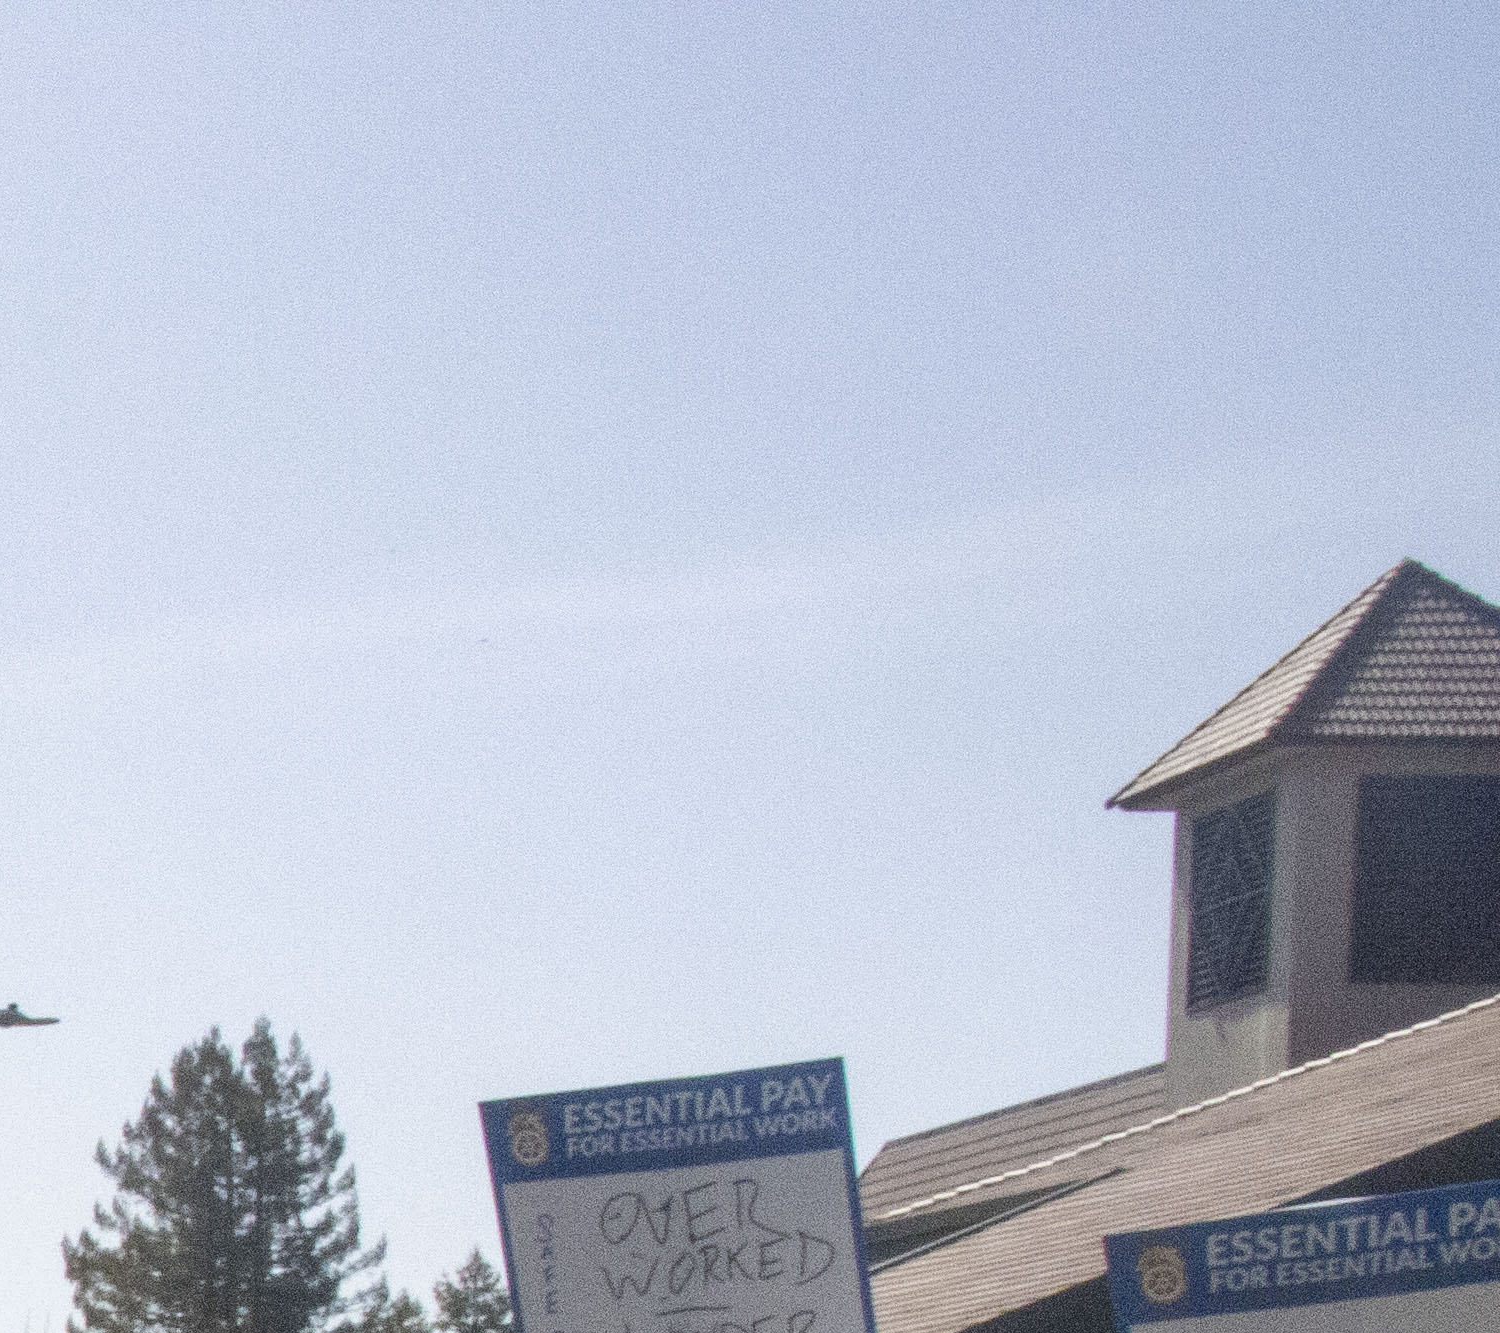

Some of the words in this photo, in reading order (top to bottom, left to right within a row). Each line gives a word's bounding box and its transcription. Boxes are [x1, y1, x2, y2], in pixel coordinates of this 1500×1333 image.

[562, 1082, 750, 1135] ESSENTIAL
[760, 1072, 834, 1109] PAY
[566, 1132, 616, 1160] FOR
[619, 1116, 748, 1155] ESSENTIAL
[753, 1105, 838, 1138] WORK
[601, 1177, 792, 1245] OVER
[1204, 1208, 1437, 1268] ESSENTIAL
[603, 1231, 837, 1302] WORKED
[1208, 1267, 1269, 1294] FOR
[1275, 1247, 1433, 1286] ESSENTIAL
